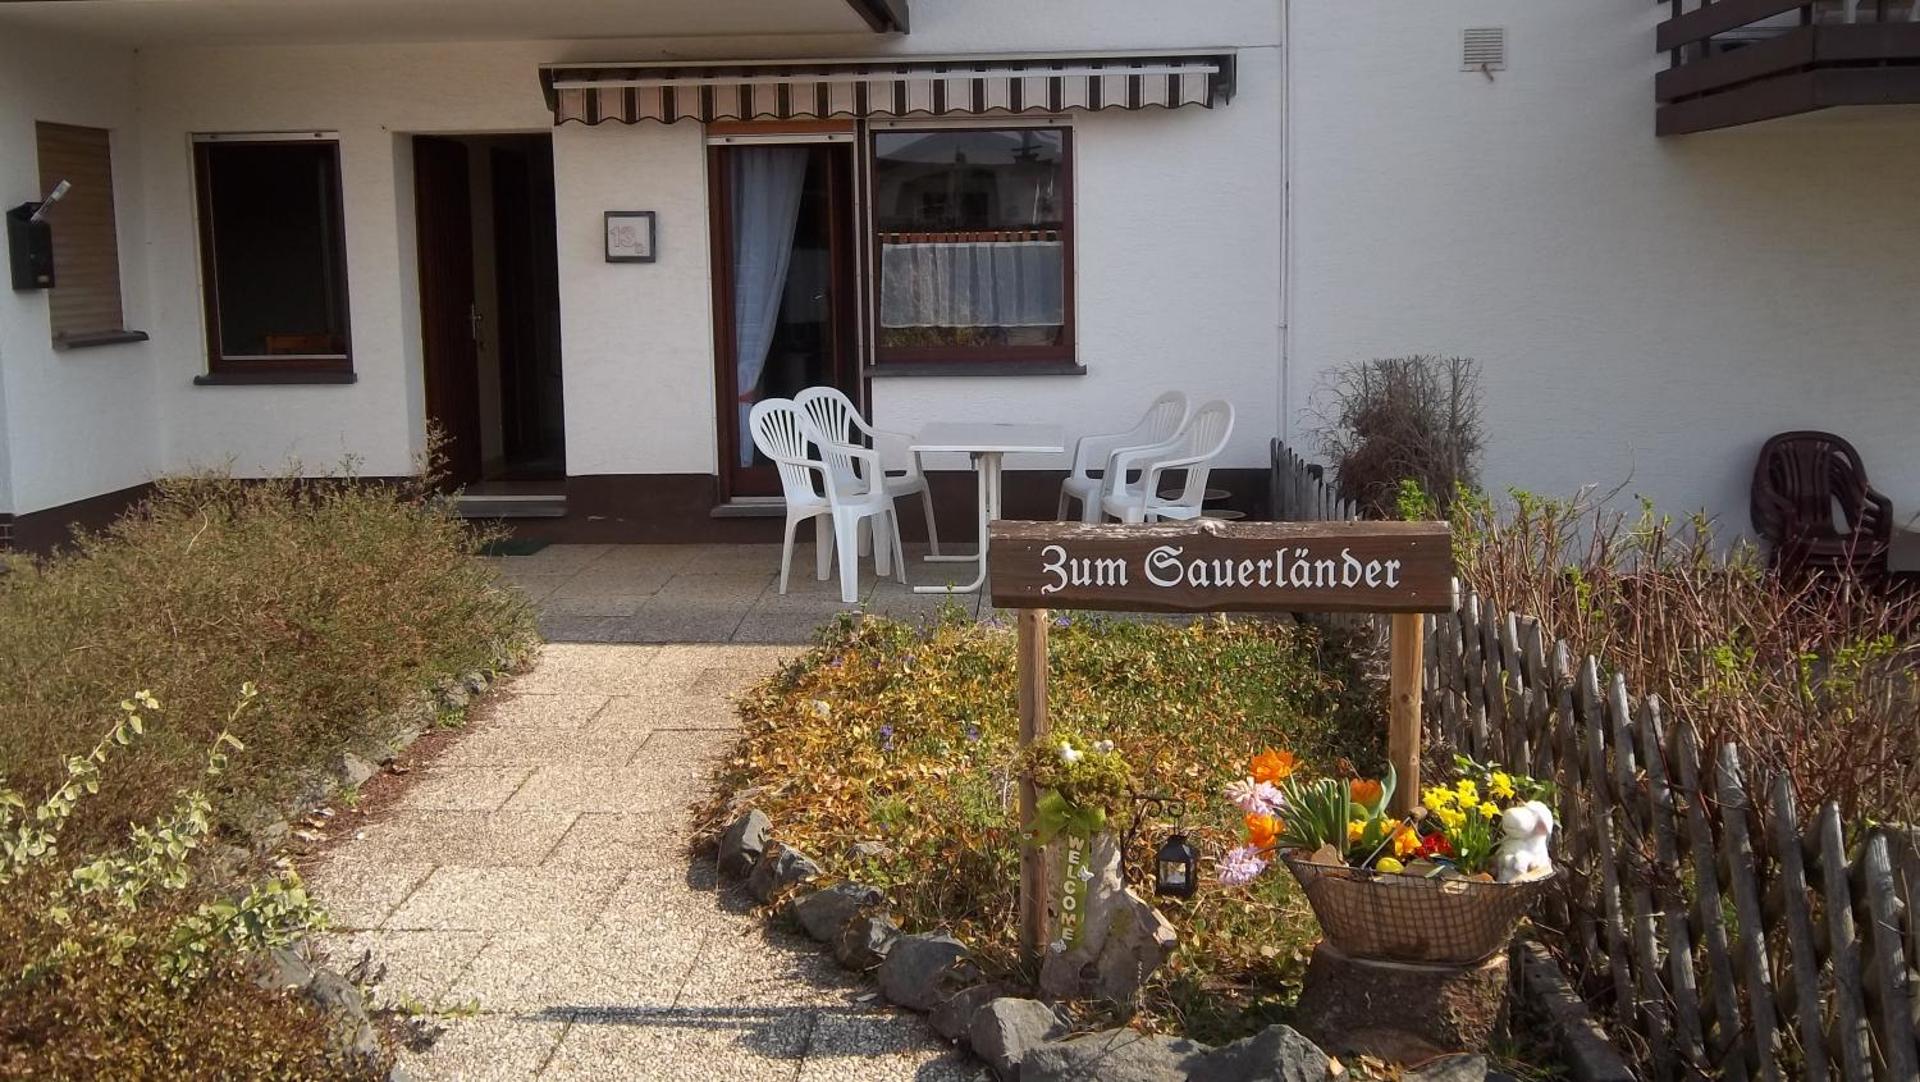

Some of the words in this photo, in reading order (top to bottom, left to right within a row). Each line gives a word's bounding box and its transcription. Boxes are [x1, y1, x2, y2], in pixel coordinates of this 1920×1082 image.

[1041, 545, 1129, 595] Zum
[1144, 545, 1401, 589] Sauerländer
[1061, 835, 1085, 941] WELCOME
